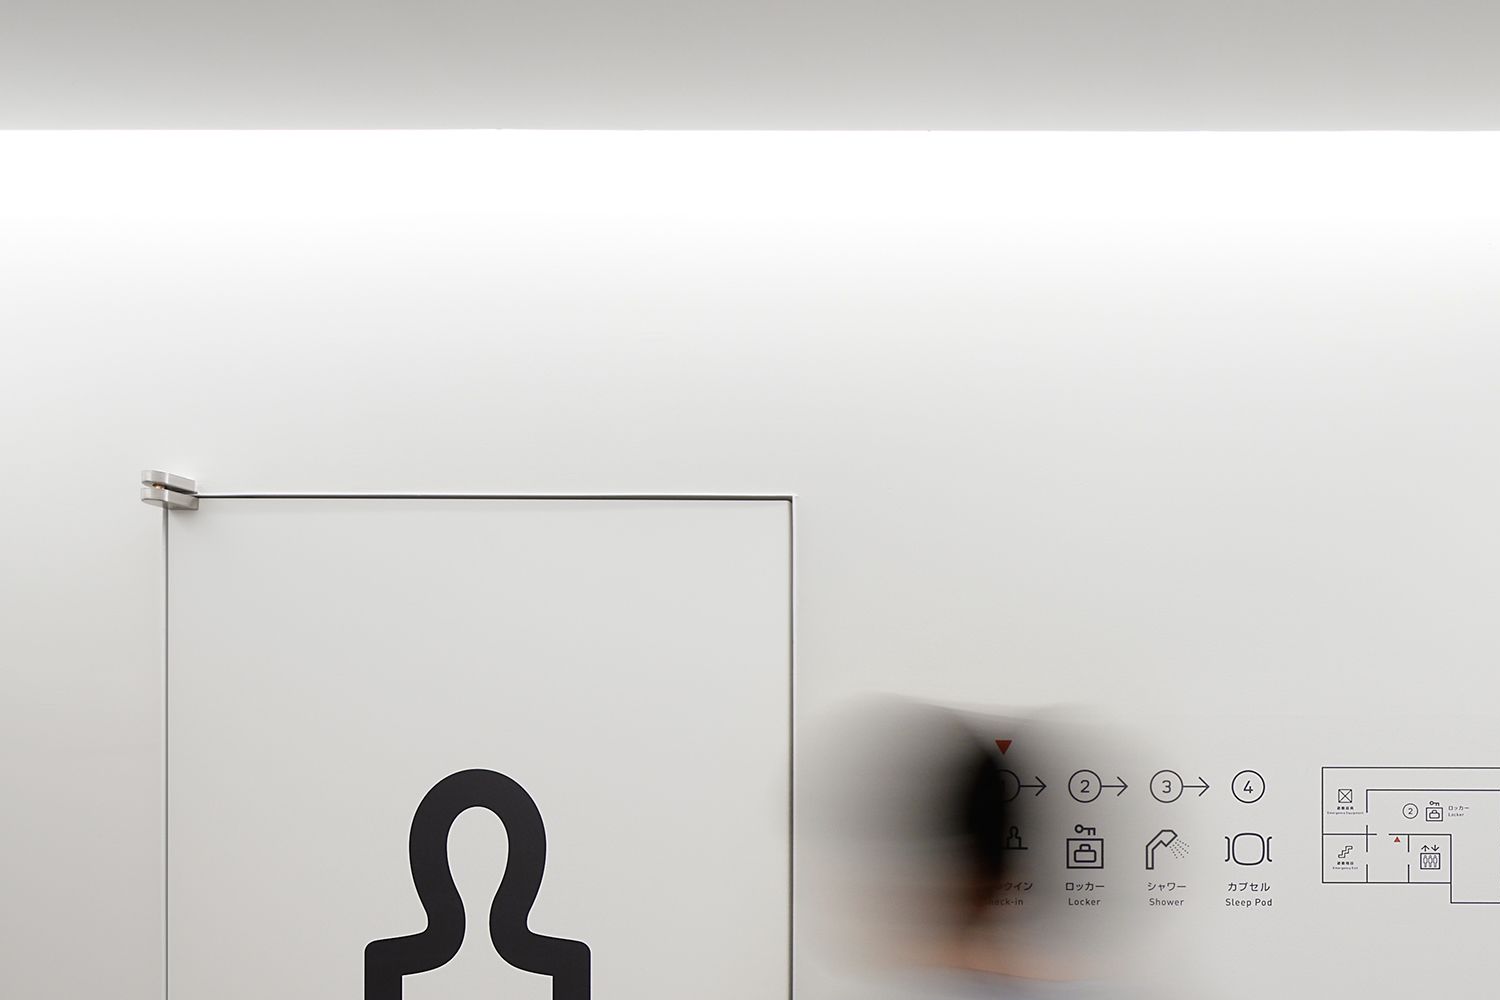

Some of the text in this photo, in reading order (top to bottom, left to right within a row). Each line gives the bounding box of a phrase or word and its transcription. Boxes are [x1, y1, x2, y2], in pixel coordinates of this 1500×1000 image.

[1080, 779, 1090, 794] 2
[1161, 779, 1172, 794] 3
[1243, 780, 1254, 794] 4
[1065, 881, 1105, 892] ロッカー
[1147, 881, 1187, 892] シャワー
[1067, 897, 1101, 906] Locker
[1148, 897, 1185, 907] Shower
[1225, 897, 1273, 908] Sleep Pod
